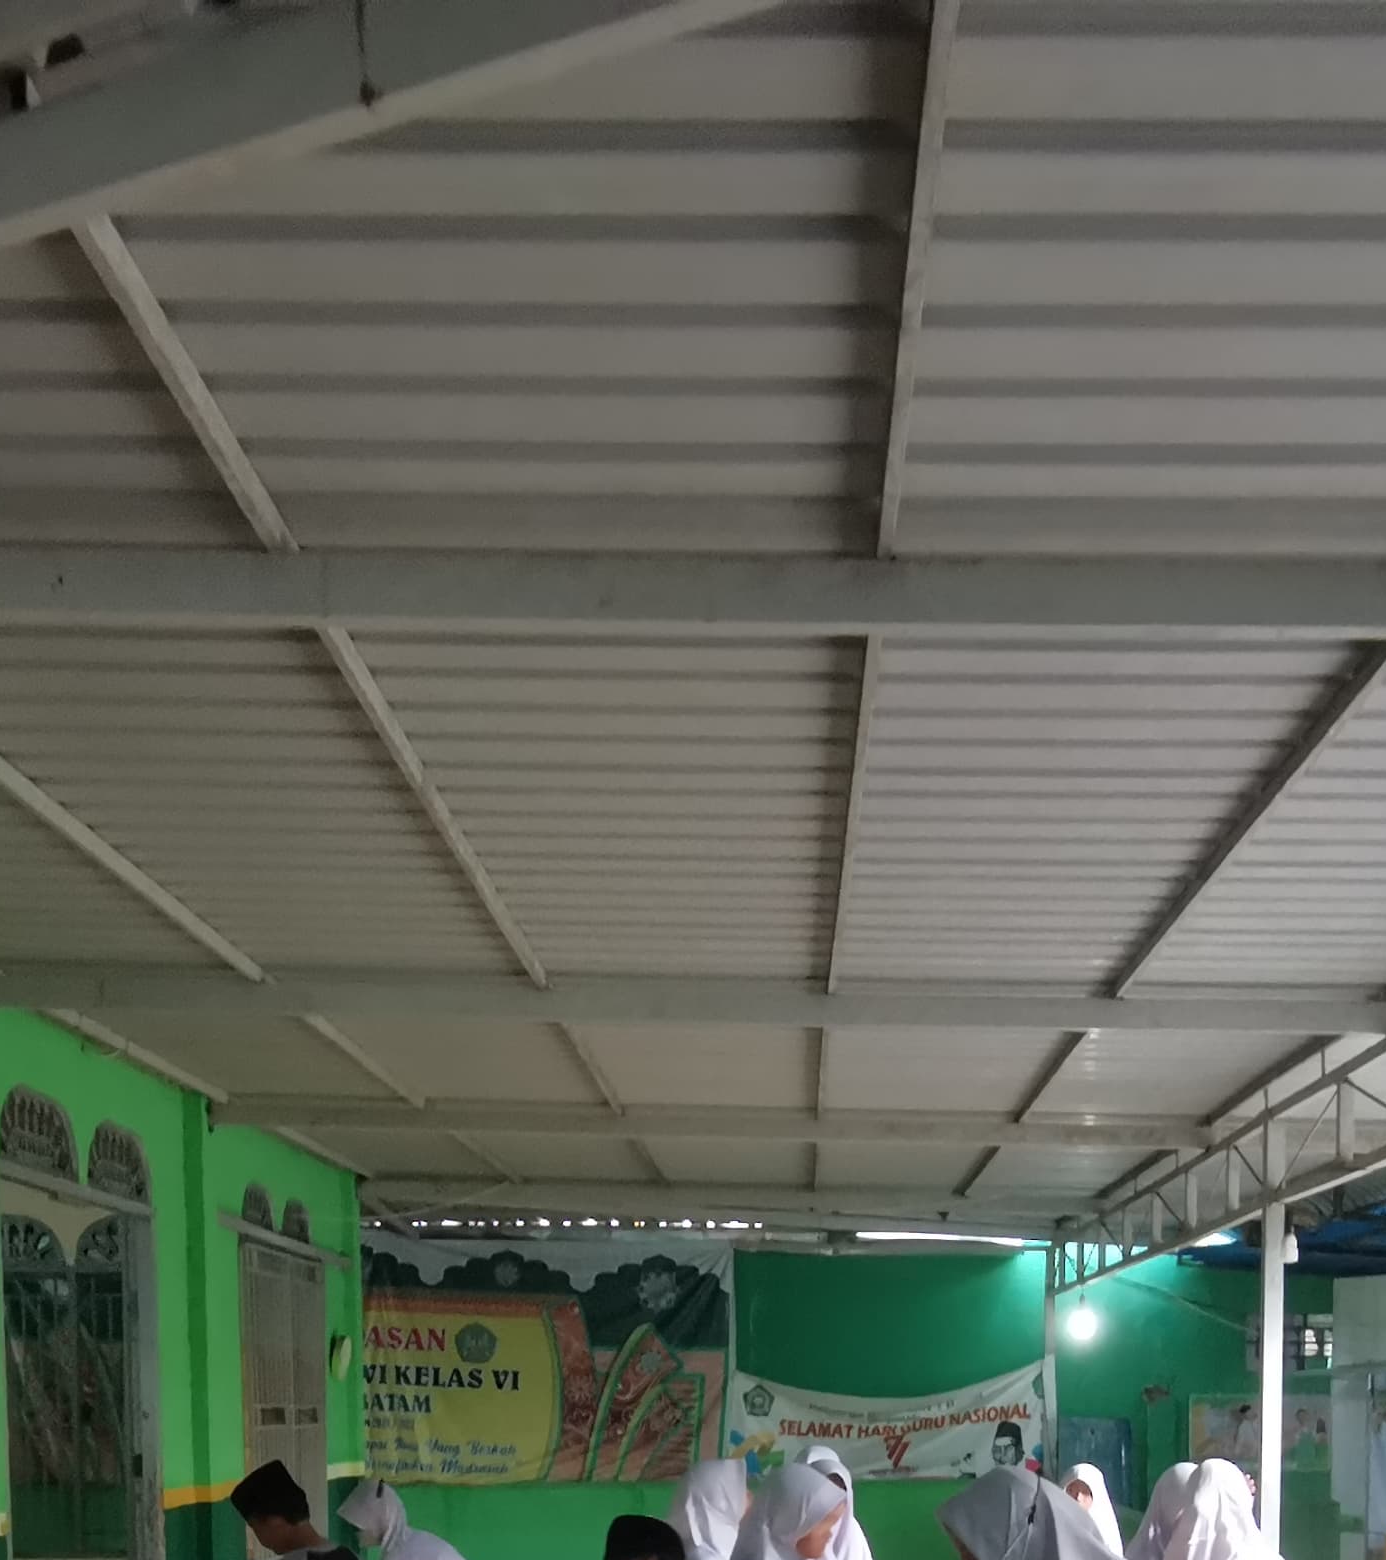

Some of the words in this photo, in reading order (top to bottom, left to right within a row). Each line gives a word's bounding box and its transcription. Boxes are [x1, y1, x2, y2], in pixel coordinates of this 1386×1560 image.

[395, 1365, 484, 1390] KELAS
[492, 1369, 521, 1391] VI
[778, 1418, 853, 1438] SELAMAT
[949, 1402, 1032, 1427] NASIONAL
